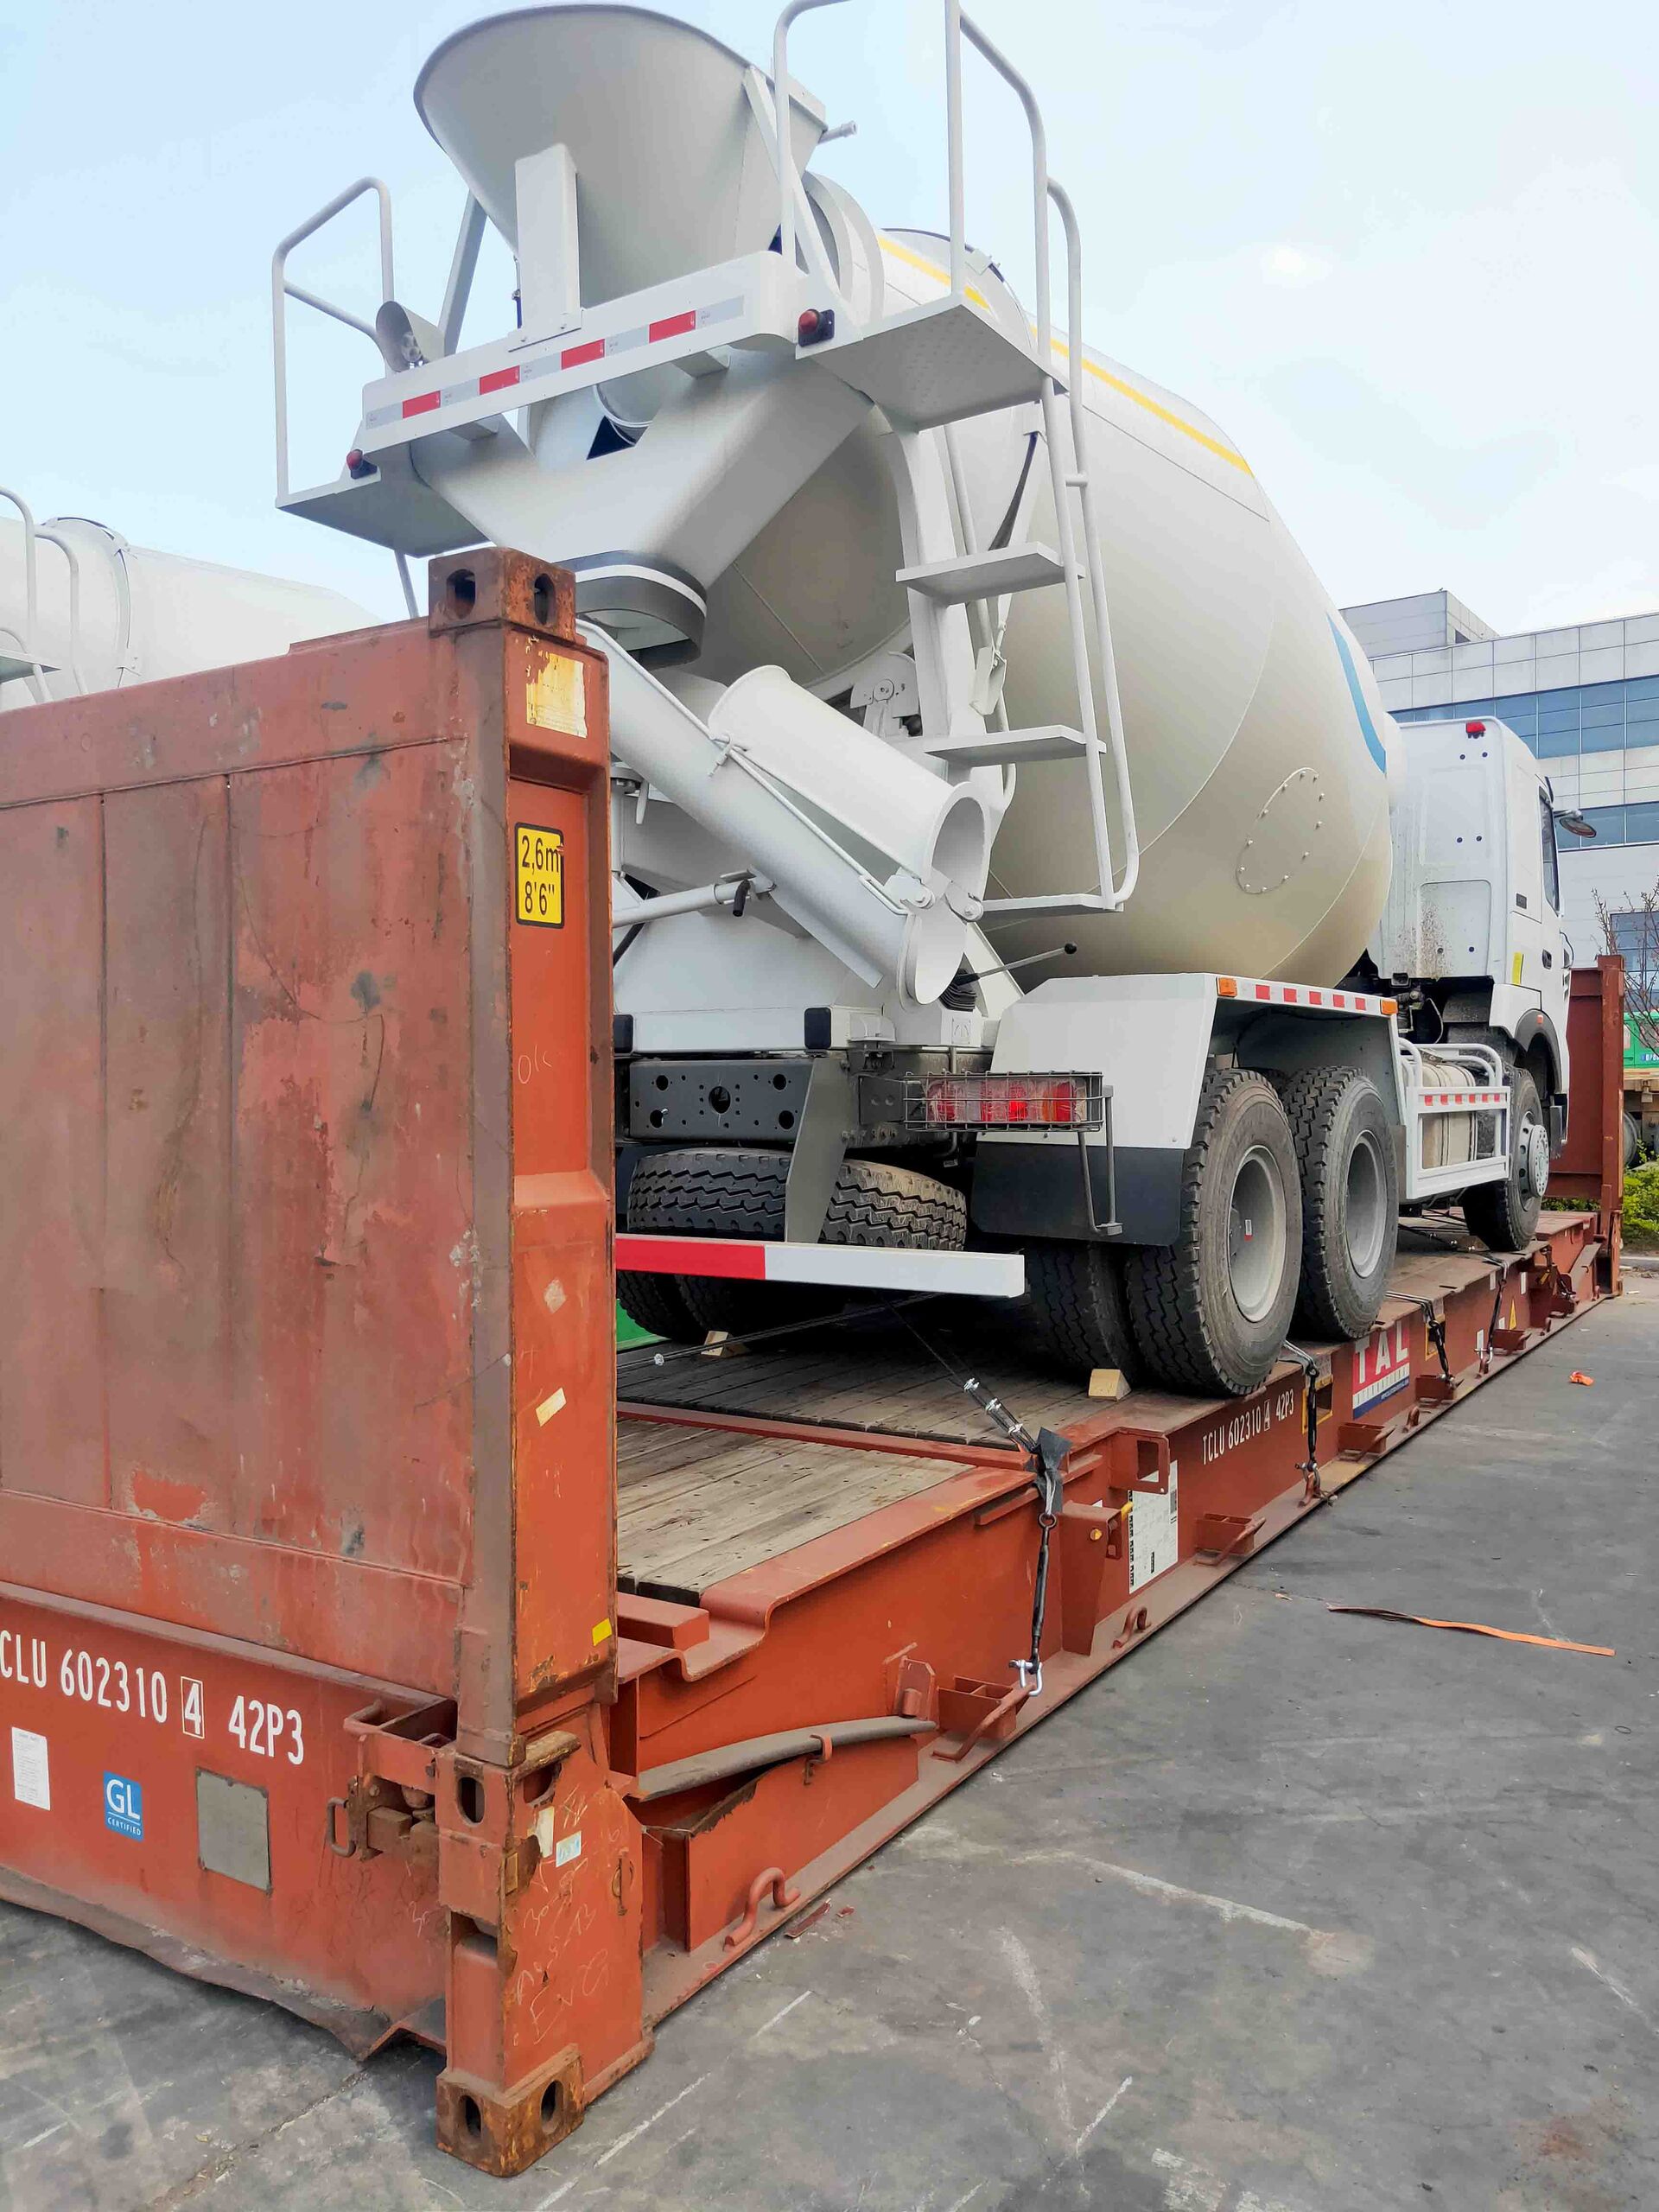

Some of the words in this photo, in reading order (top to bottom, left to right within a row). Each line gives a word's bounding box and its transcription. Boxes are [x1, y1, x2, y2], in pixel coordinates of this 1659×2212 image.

[521, 835, 560, 874] 2,6m
[1354, 1320, 1408, 1384] TAL
[1202, 1424, 1225, 1465] TCLU
[1228, 1405, 1262, 1450] 602310
[1263, 1401, 1270, 1431] 4
[1275, 1388, 1294, 1421] 42P3
[0, 1630, 47, 1688] CLU
[60, 1649, 168, 1723] 602310
[183, 1681, 202, 1736] 4
[228, 1695, 304, 1765] 42P3
[106, 1778, 141, 1821] GL
[107, 1816, 142, 1836] CERTIFIED
